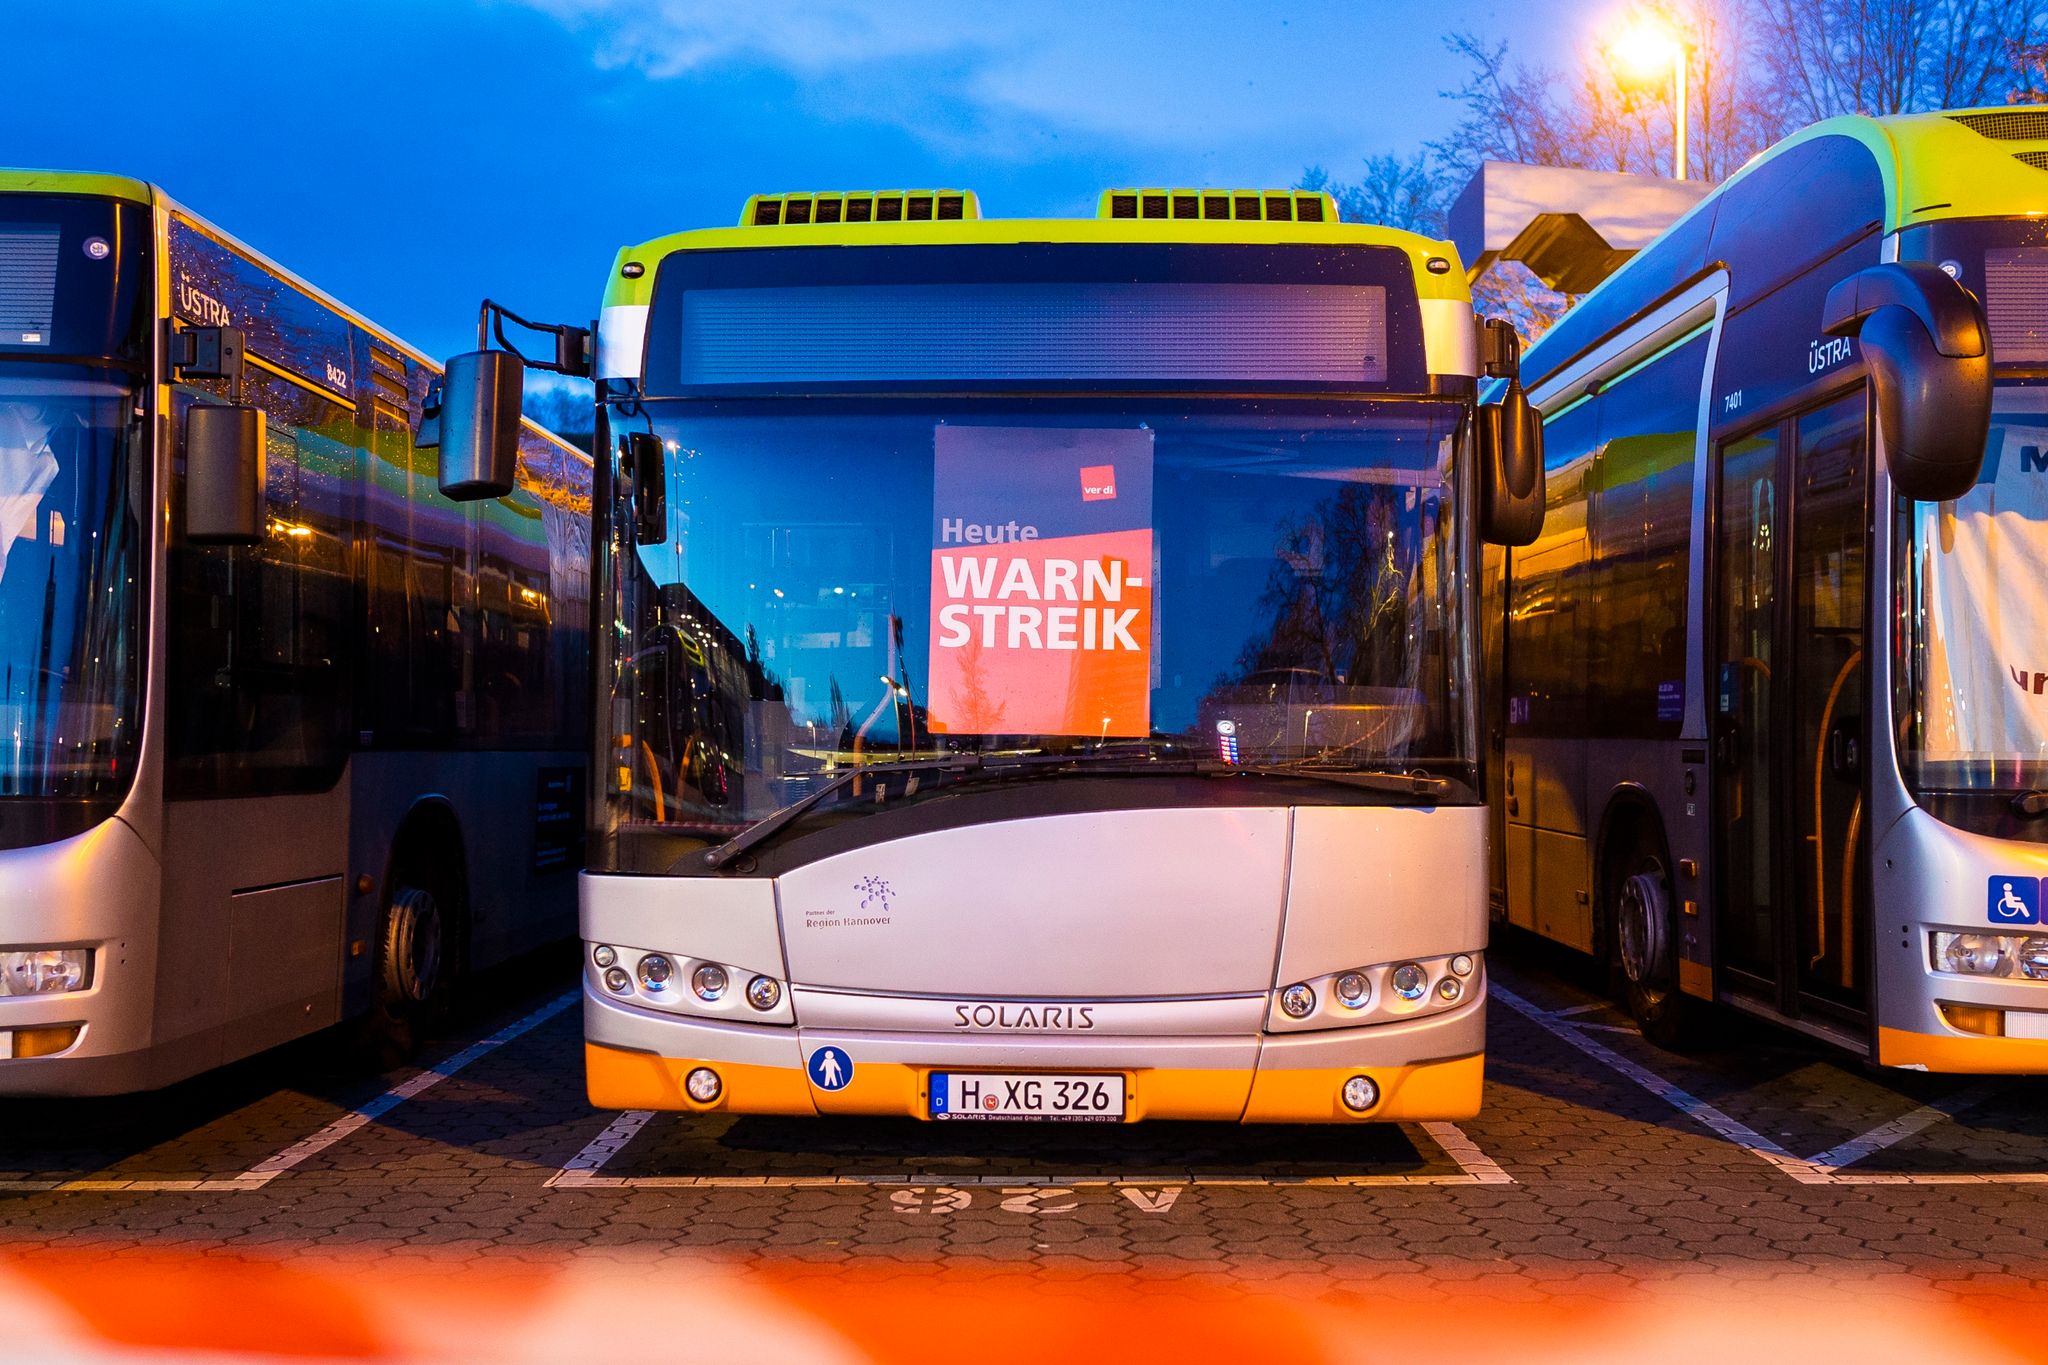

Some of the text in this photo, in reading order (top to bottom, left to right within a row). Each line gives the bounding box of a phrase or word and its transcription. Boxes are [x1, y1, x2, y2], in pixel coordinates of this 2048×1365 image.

[181, 271, 230, 327] ÜSTRA
[1808, 336, 1852, 374] ÜSTRA
[326, 363, 347, 389] 8422
[1724, 389, 1742, 413] 7401
[941, 518, 1039, 544] Heute
[940, 556, 1143, 602] WARN-
[938, 604, 1141, 651] STREIK
[806, 917, 891, 930] Region Hannover
[954, 1004, 1094, 1029] SOLARIS
[935, 1080, 1110, 1111] D H XG 326
